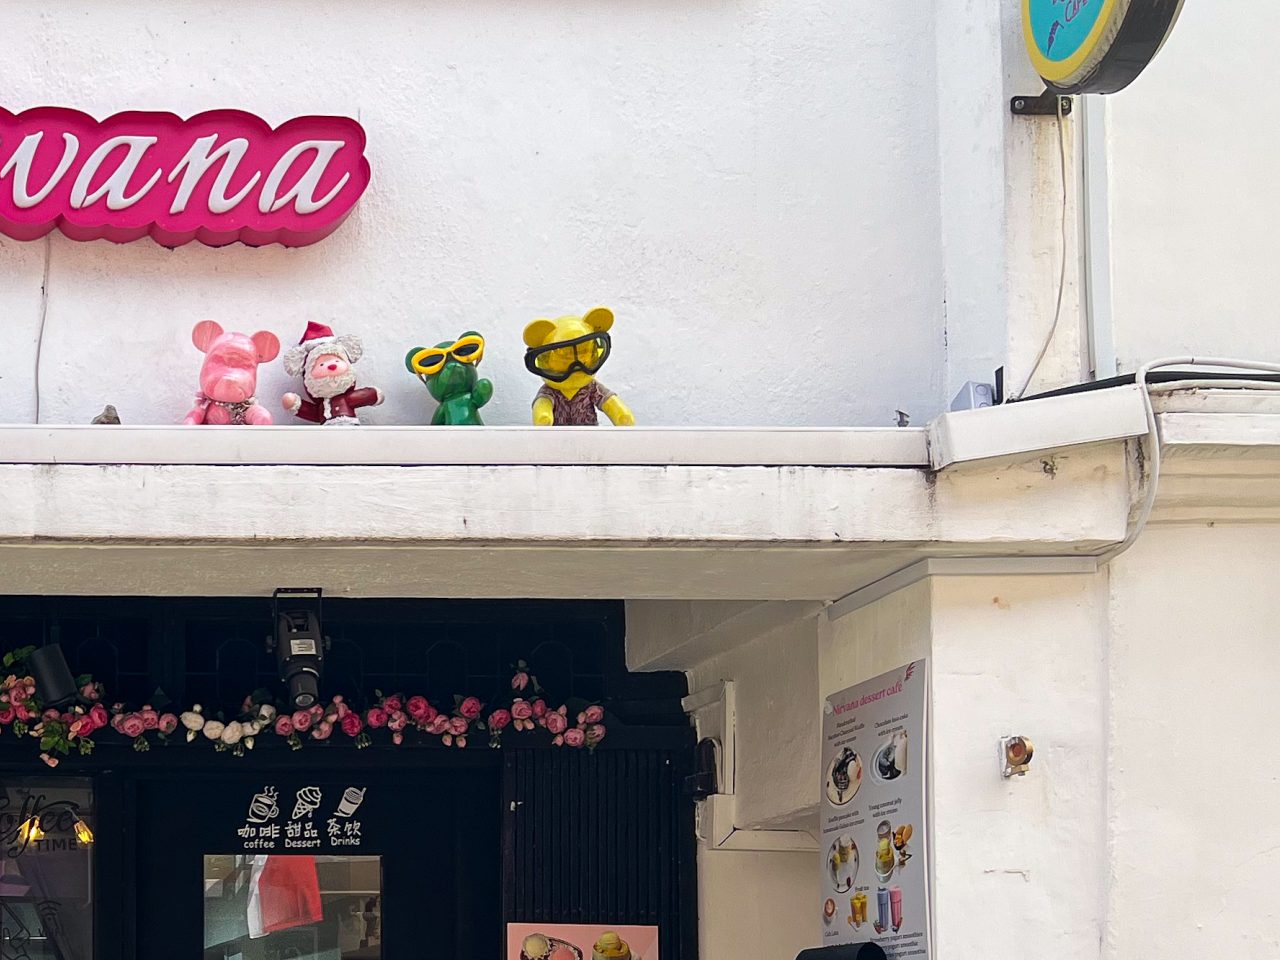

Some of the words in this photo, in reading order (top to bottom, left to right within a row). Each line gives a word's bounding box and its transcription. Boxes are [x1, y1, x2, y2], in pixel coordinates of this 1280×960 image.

[833, 700, 860, 715] Nirvana
[860, 690, 887, 706] dessert
[237, 823, 280, 838] 咖啡
[284, 821, 318, 838] 甜品
[34, 839, 78, 851] TIME
[243, 839, 276, 849] coffee
[285, 838, 321, 848] Dessert
[331, 836, 360, 846] Drinks
